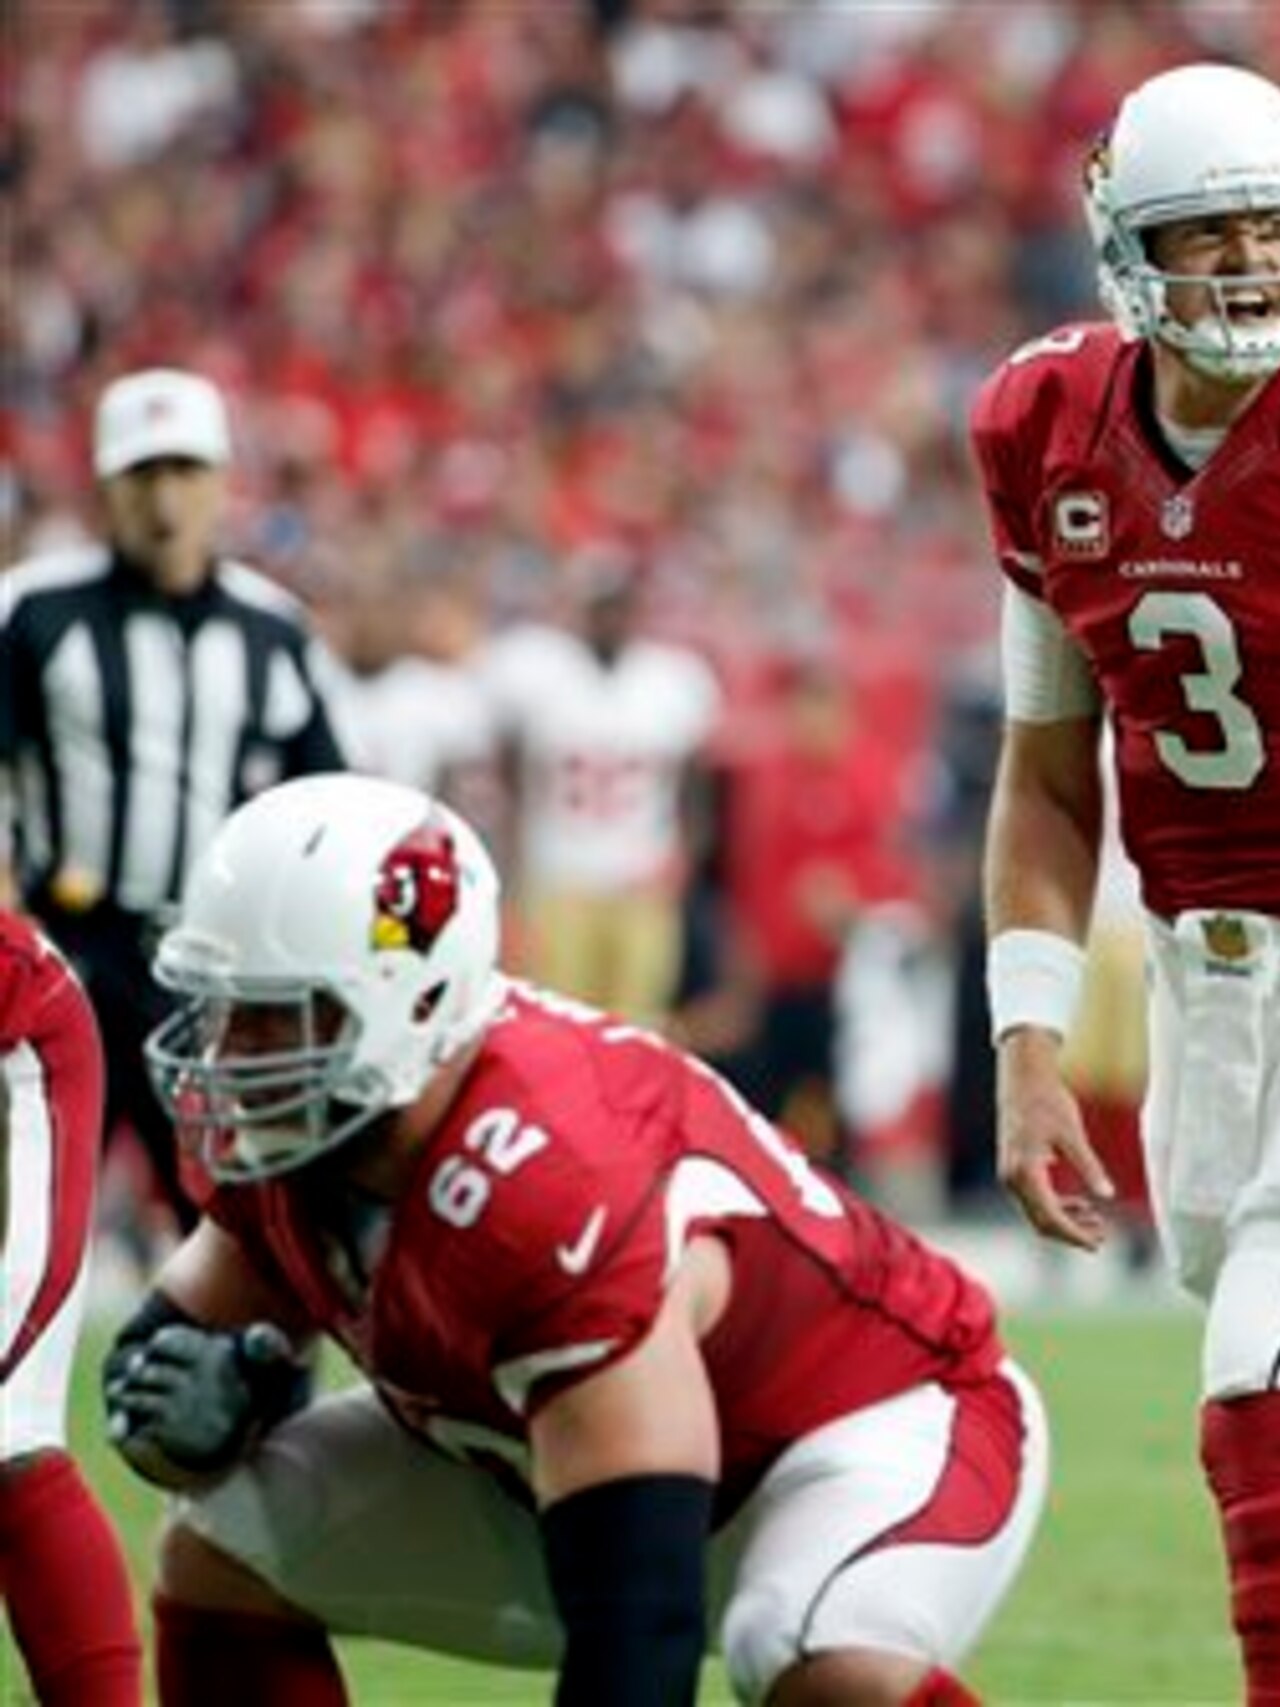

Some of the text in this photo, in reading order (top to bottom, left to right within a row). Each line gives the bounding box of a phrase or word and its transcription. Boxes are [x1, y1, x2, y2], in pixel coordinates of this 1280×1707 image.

[1056, 496, 1101, 541] C
[1128, 591, 1267, 789] 3
[428, 1107, 551, 1229] 62
